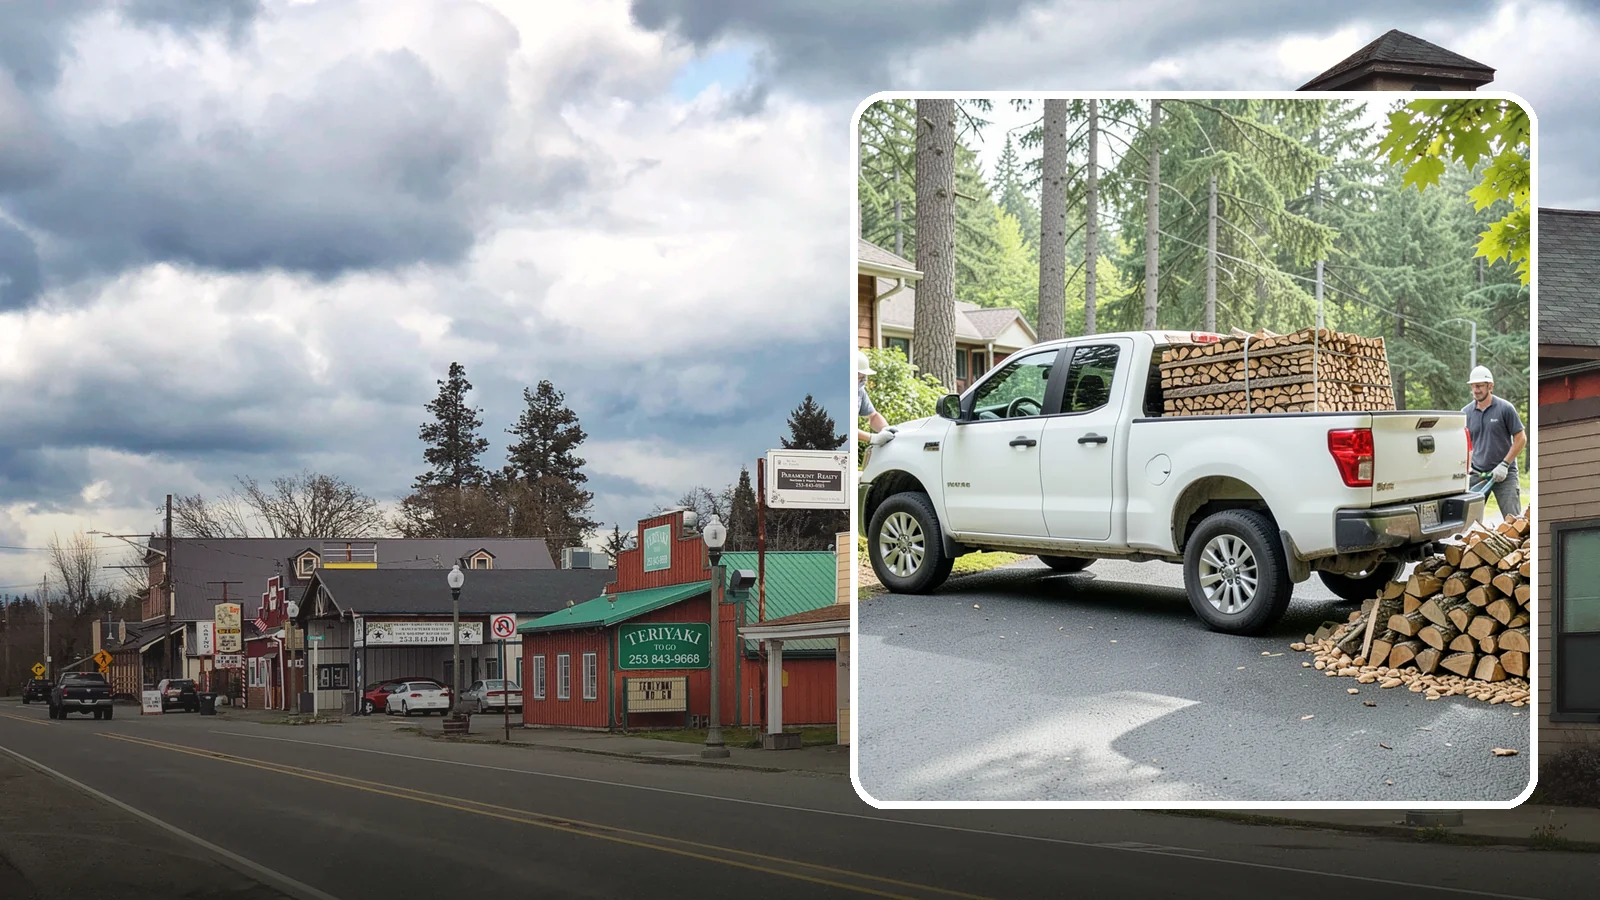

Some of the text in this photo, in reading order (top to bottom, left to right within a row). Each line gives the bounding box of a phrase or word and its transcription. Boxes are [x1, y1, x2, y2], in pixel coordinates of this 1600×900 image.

[817, 472, 839, 480] REALTY
[625, 627, 703, 646] TERIYAKI
[628, 653, 700, 665] 253 843-9668
